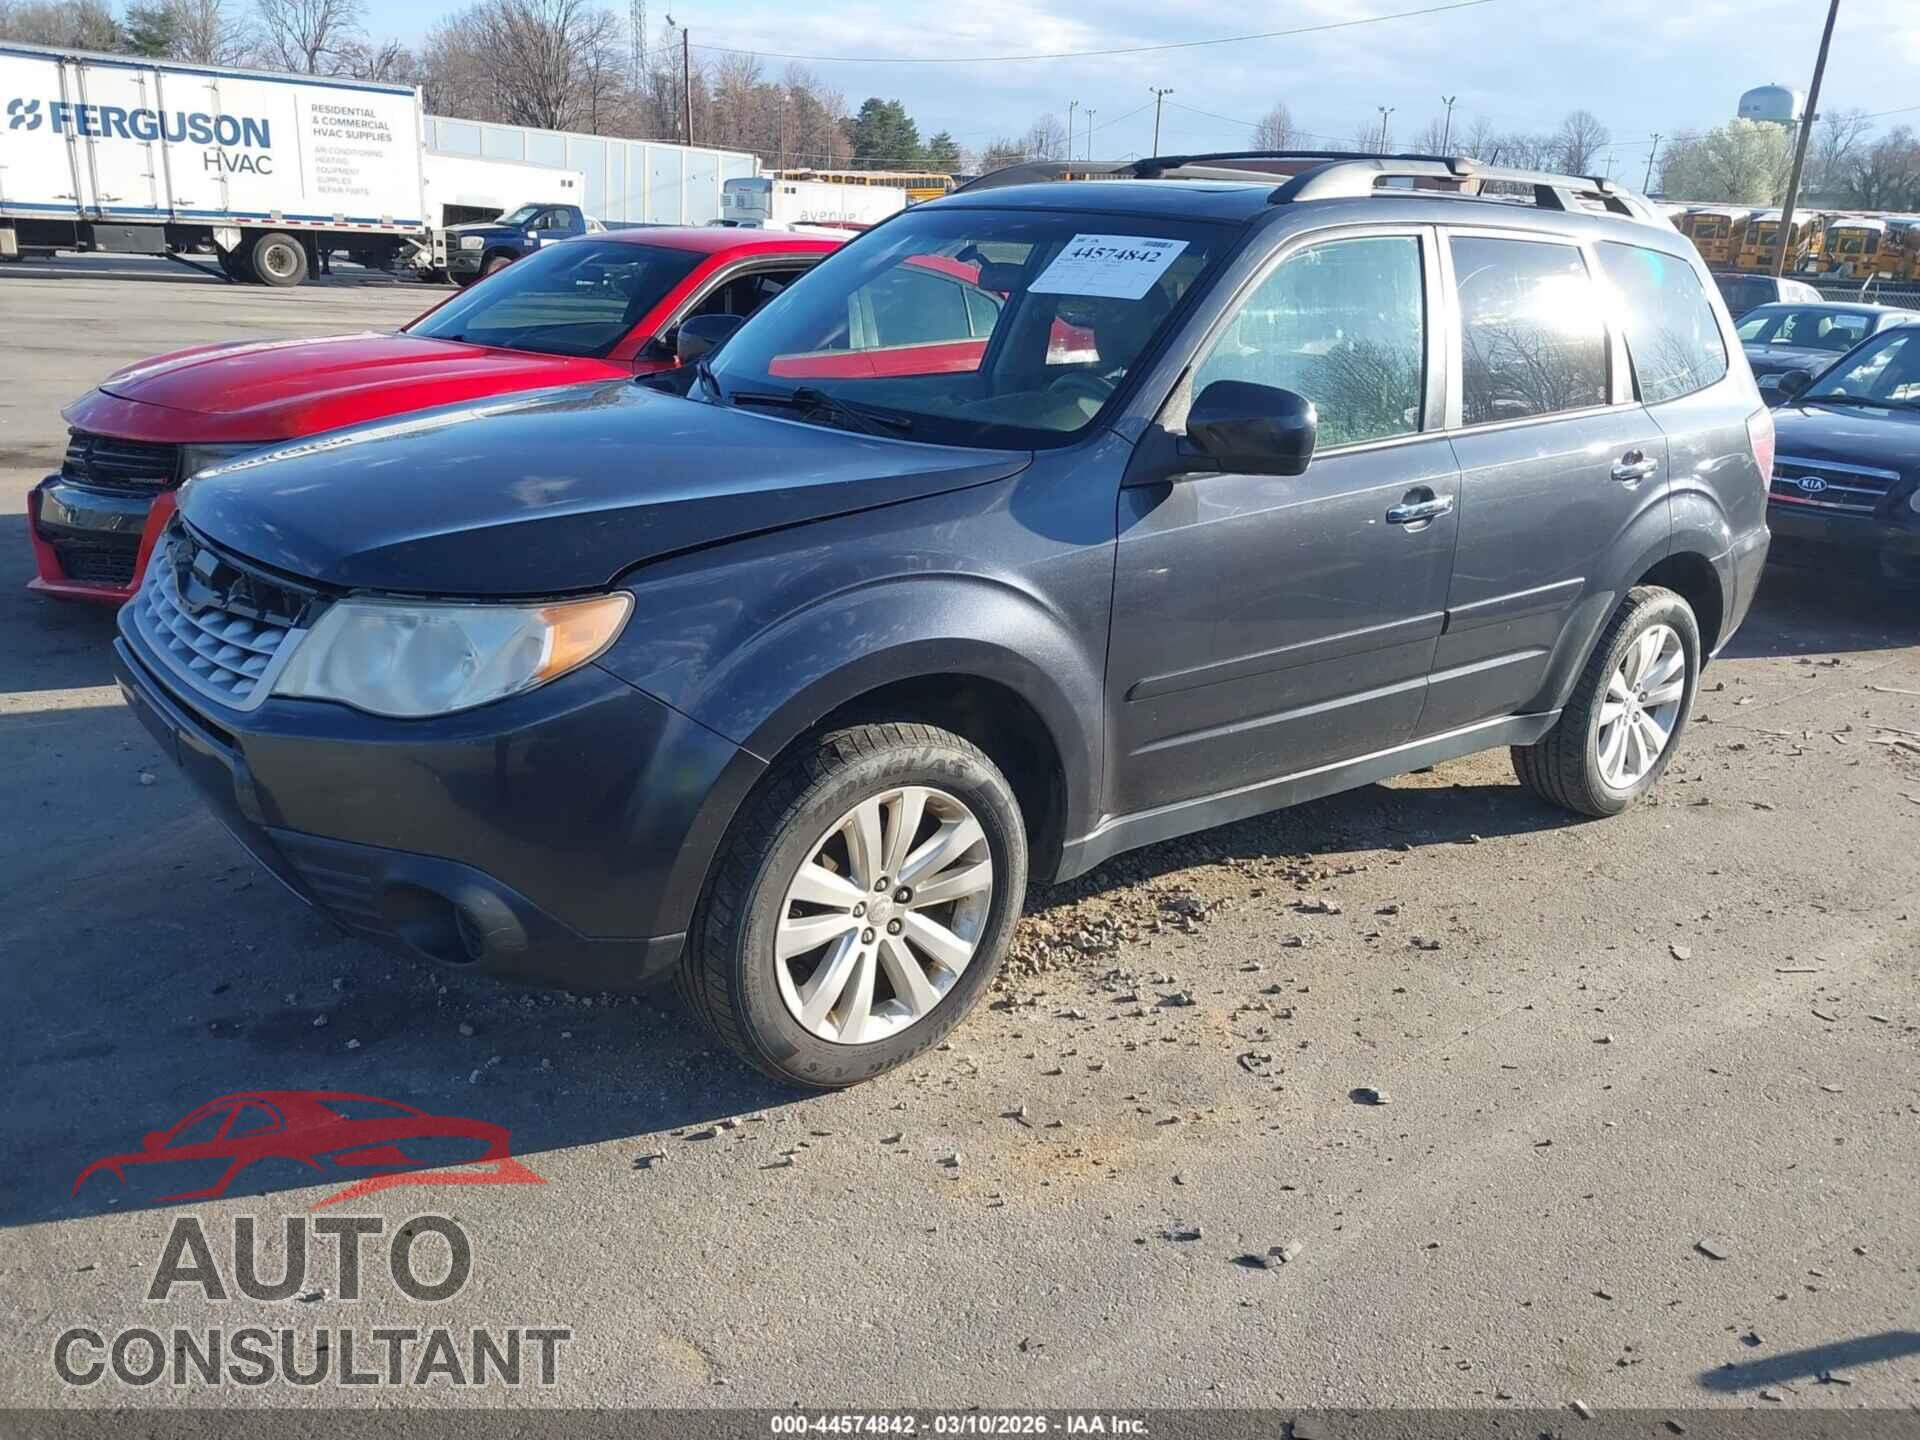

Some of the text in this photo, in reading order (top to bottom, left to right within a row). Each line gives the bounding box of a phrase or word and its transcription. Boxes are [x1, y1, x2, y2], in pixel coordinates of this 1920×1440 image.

[311, 104, 376, 118] RESIDENTIAL
[49, 101, 271, 148] FERGUSON
[312, 115, 389, 130] & COMMERCIAL
[313, 127, 392, 142] HVAC SUPPLIES
[203, 151, 272, 175] HVAC
[800, 209, 857, 222] avenue
[1072, 247, 1162, 263] 44574842
[1801, 479, 1822, 489] KIA
